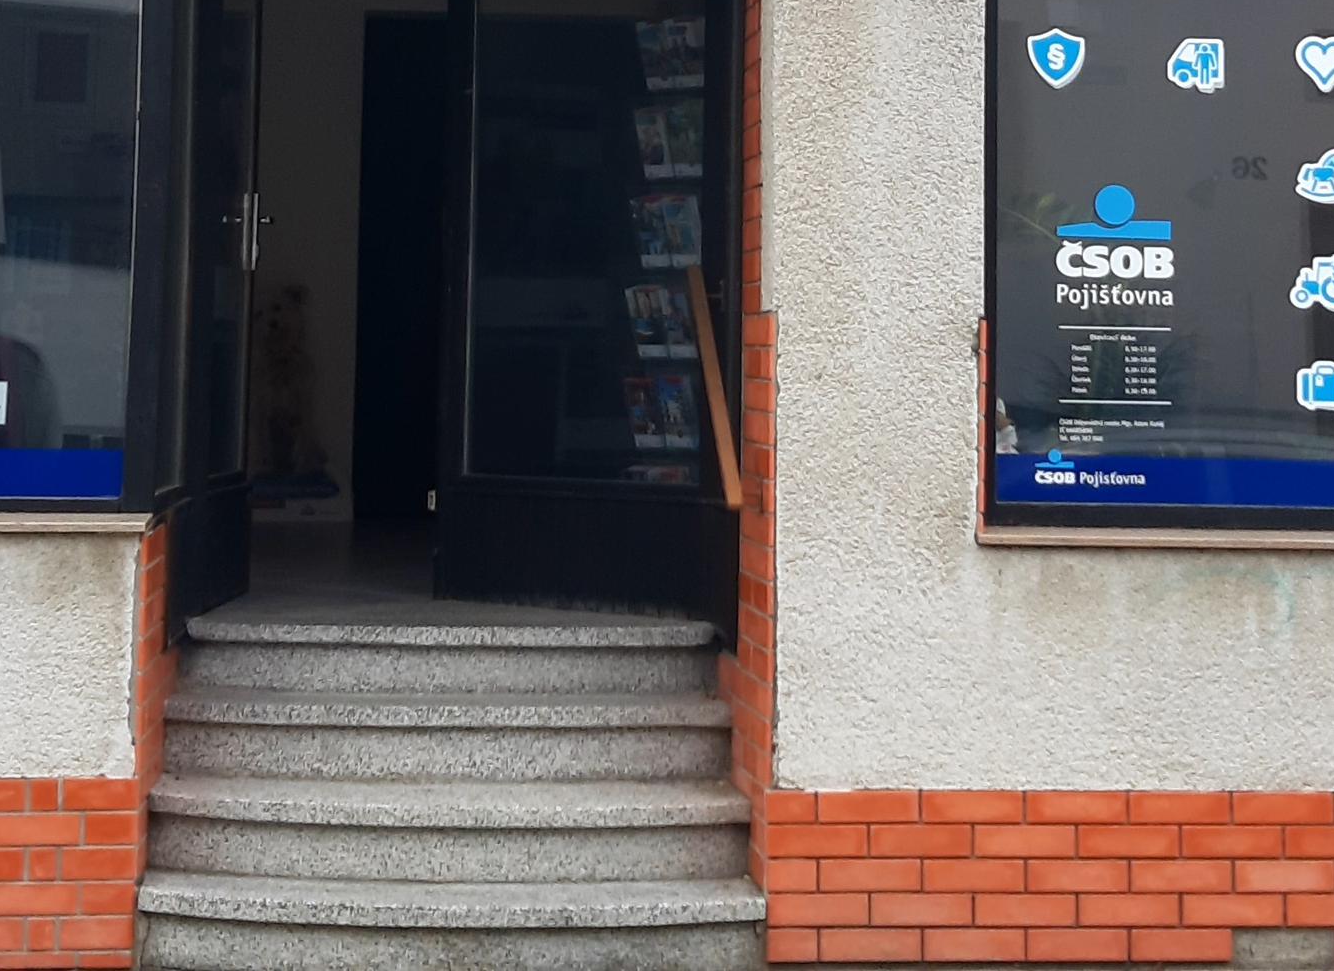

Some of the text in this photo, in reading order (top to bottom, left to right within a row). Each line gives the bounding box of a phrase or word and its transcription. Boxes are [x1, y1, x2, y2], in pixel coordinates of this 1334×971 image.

[1055, 240, 1175, 279] ČSOB
[1056, 283, 1174, 310] Pojišťovna
[1034, 469, 1076, 485] ČSOB
